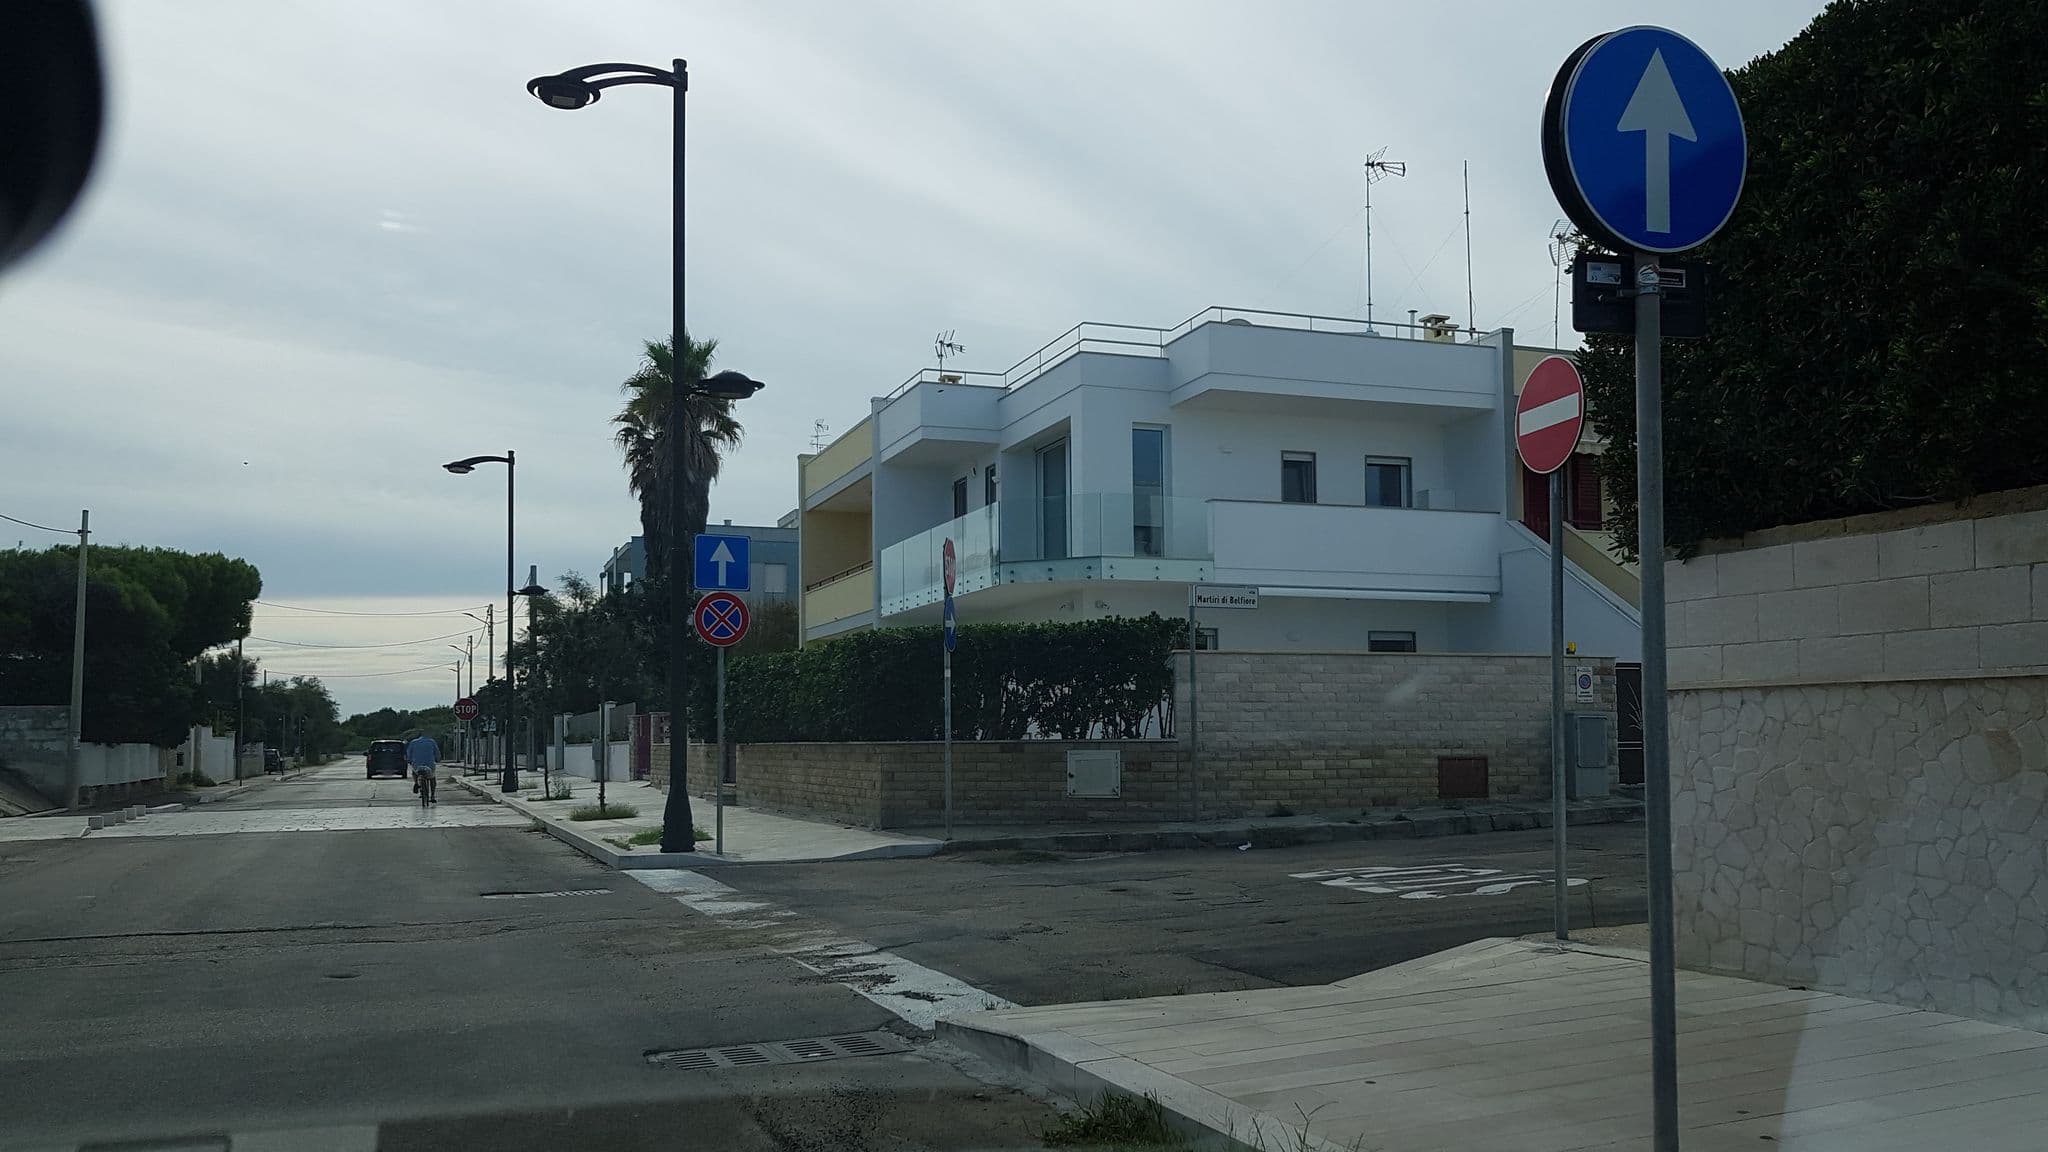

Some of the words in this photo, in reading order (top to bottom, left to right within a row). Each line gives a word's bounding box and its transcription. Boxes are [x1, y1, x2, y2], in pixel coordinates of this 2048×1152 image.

[1197, 595, 1220, 604] Martiri
[1221, 596, 1228, 604] di
[1229, 596, 1256, 605] Belfiore
[455, 705, 477, 714] STOP
